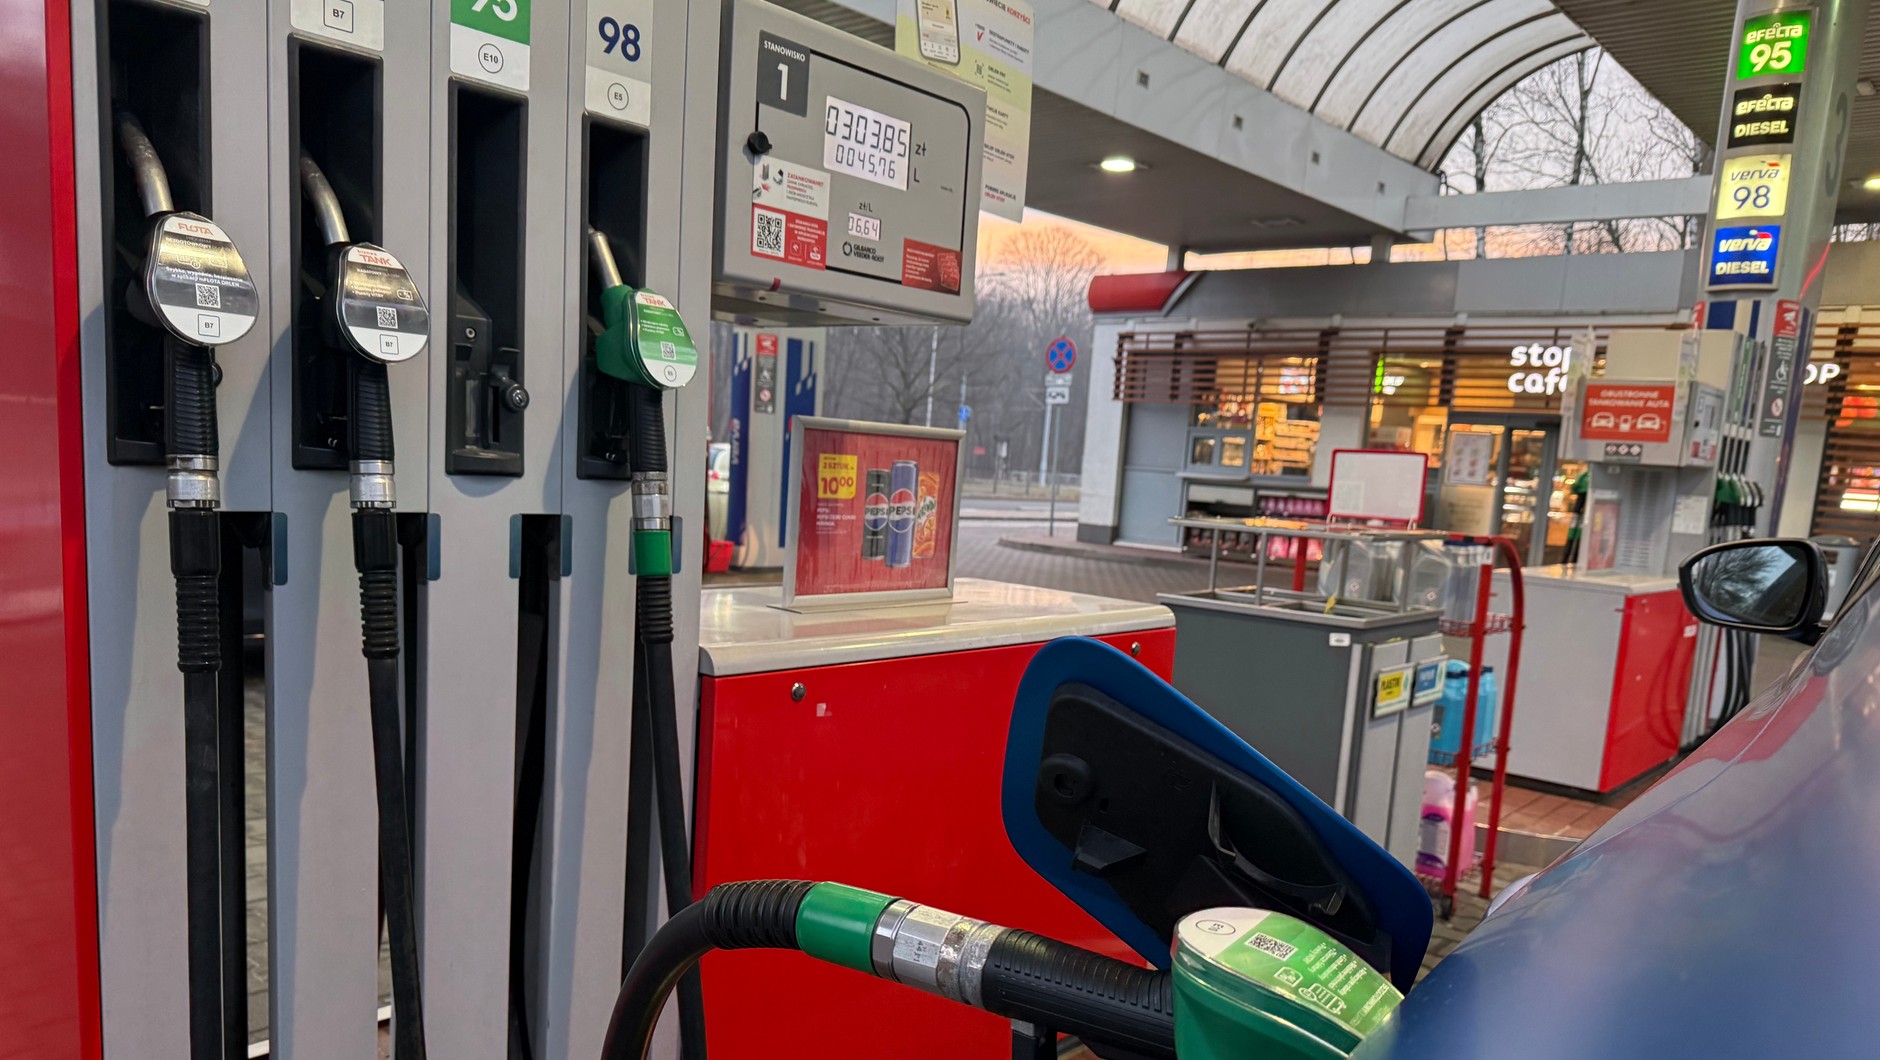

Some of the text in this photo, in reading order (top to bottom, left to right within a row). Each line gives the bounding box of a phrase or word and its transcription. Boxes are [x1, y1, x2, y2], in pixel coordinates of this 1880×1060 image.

[332, 8, 345, 19] B7
[598, 16, 641, 62] 98
[483, 52, 499, 64] E10
[763, 40, 806, 62] STANOWISKO
[1749, 40, 1792, 73] 95
[777, 63, 789, 101] 1
[613, 91, 624, 101] E5
[1735, 93, 1794, 115] efecta
[1734, 119, 1789, 139] DIESEL
[915, 142, 927, 156] zł
[913, 168, 920, 183] L
[1730, 167, 1780, 182] verva
[1733, 184, 1771, 210] 98
[858, 202, 873, 212] zł/L
[178, 222, 214, 236] FLOTA
[853, 243, 877, 255] GILBARCO
[1718, 236, 1772, 253] verva
[359, 254, 392, 266] TANK
[1715, 259, 1770, 276] DIESEL
[204, 321, 214, 329] B7
[1600, 389, 1660, 399] OBUSTRONNE
[1588, 398, 1670, 408] TANKOWANIE AUTA
[865, 507, 889, 515] PEPSI
[889, 505, 915, 515] PEPSI
